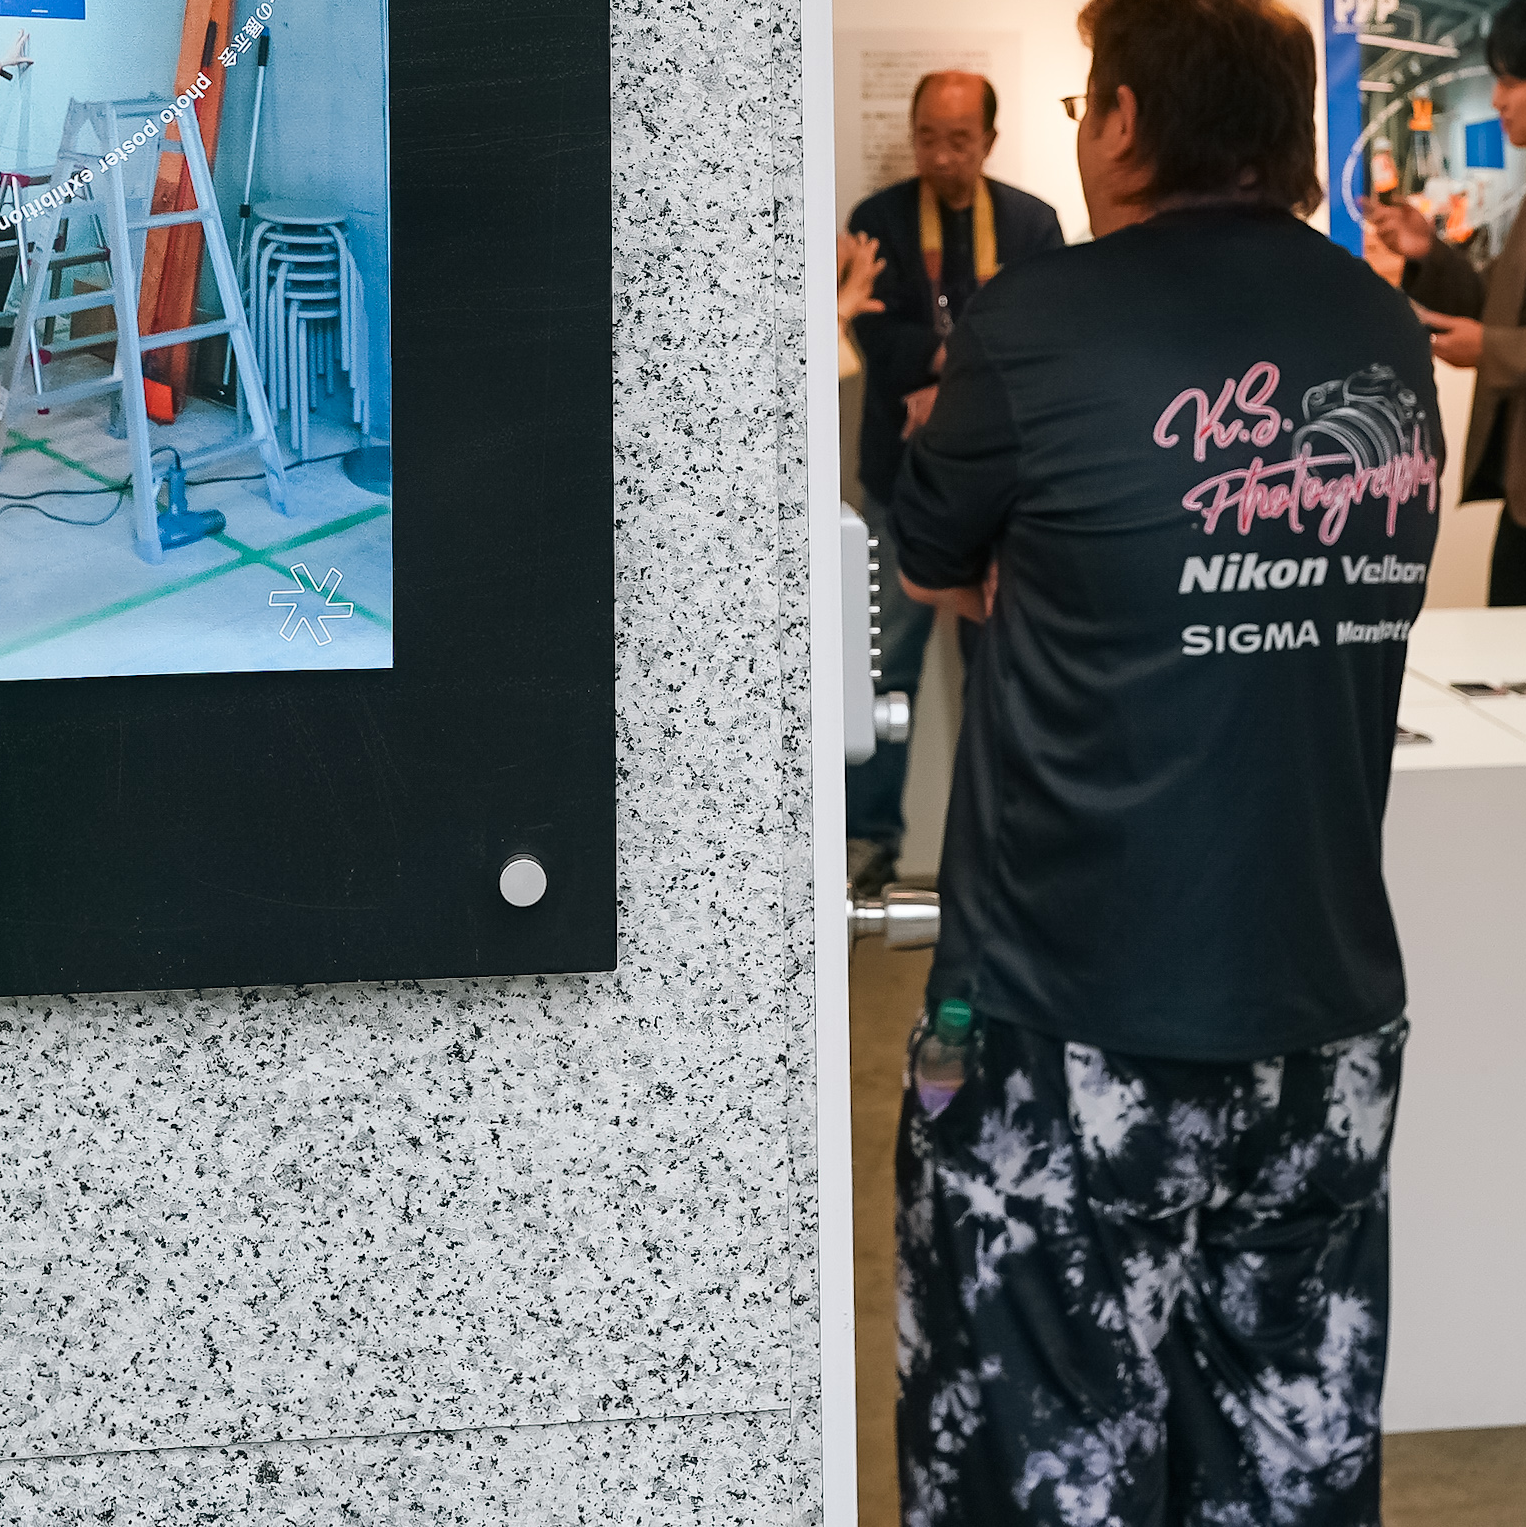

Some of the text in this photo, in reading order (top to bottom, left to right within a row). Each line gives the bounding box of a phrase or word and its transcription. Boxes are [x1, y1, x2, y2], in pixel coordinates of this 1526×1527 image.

[159, 71, 213, 125] photo
[97, 118, 160, 174] poster
[1177, 552, 1329, 595] Nikon
[1181, 619, 1321, 657] SIGMA
